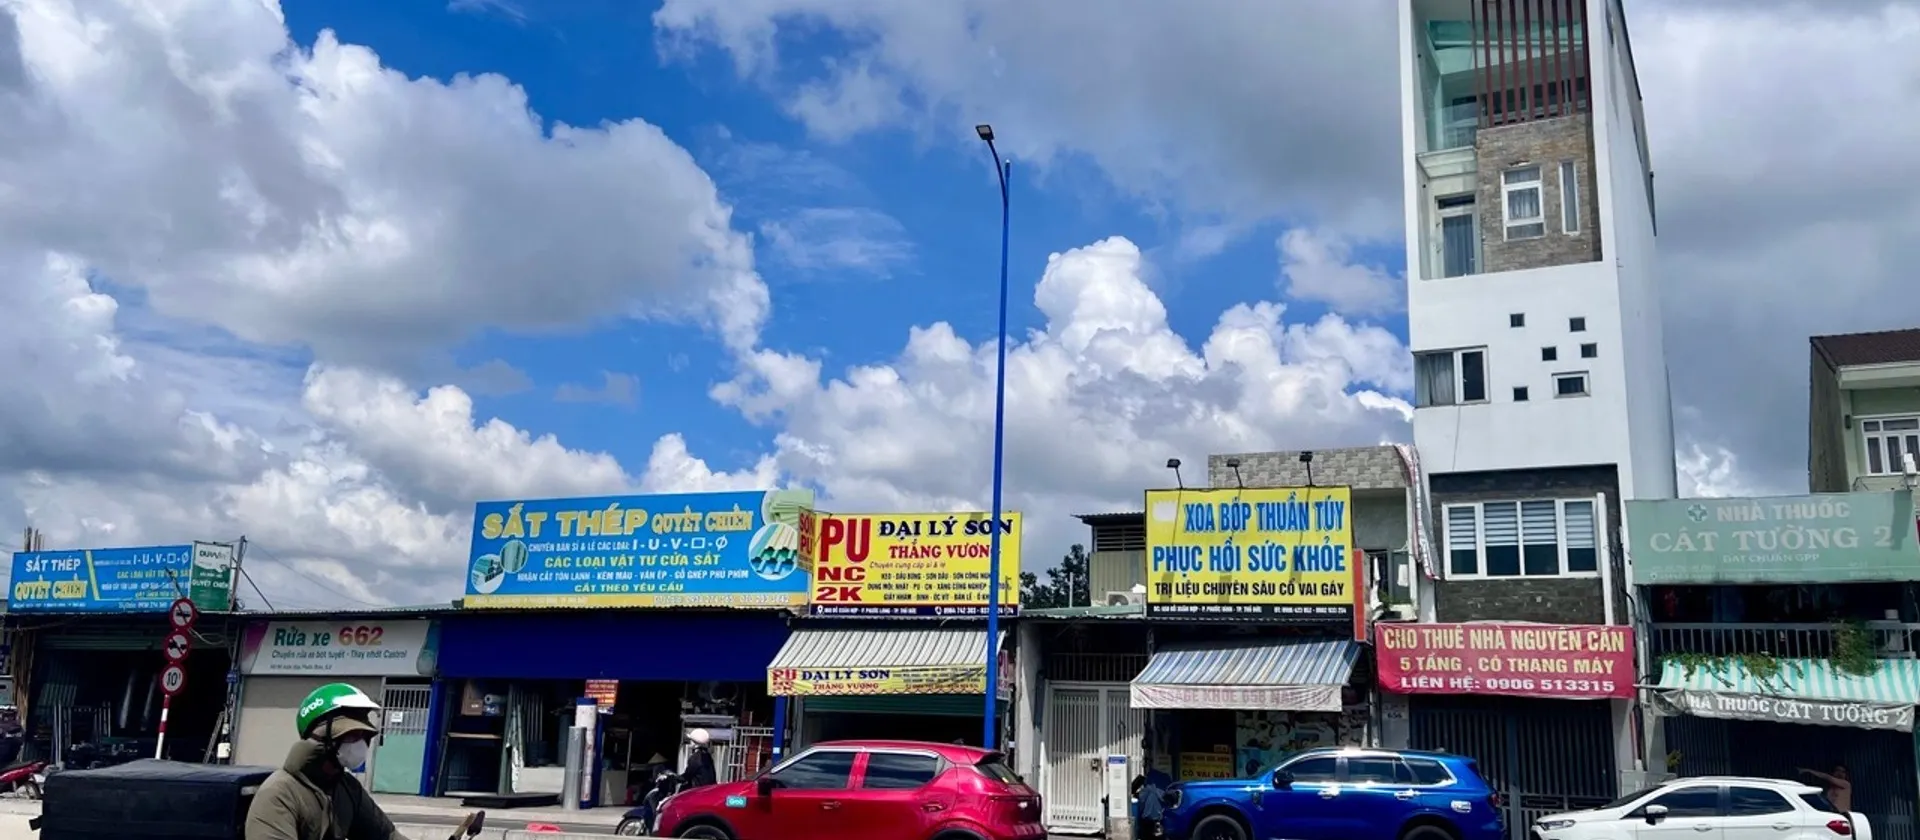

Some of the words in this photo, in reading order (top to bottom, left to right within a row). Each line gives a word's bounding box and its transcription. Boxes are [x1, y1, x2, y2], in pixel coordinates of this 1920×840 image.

[1184, 503, 1215, 533] XOA
[1256, 491, 1310, 533] THUẦN
[1313, 495, 1345, 532] TÚY
[1717, 502, 1766, 522] NHÀ
[1773, 497, 1849, 520] THUỐC
[482, 503, 548, 539] SẮT
[555, 503, 648, 536] THÉP
[879, 520, 921, 540] ĐẠI
[929, 515, 958, 536] LÝ
[648, 539, 660, 550] U
[671, 538, 682, 549] V
[820, 518, 871, 563] PU
[1732, 523, 1860, 551] TƯỜNG
[1874, 526, 1893, 547] 2
[889, 539, 941, 559] THẮNG
[1153, 544, 1203, 578] PHỤC
[1209, 536, 1241, 572] HỒI
[1248, 539, 1287, 572] SỨC
[1292, 536, 1346, 572] KHỎE
[1799, 553, 1820, 563] GPP
[26, 555, 48, 572] SẮT
[51, 555, 81, 571] THÉP
[545, 555, 571, 568] CÁC
[576, 556, 605, 571] LOẠI
[610, 555, 635, 570] VẬT
[640, 555, 658, 566] TƯ
[817, 567, 866, 581] NC
[574, 583, 596, 593] CẮT
[601, 583, 629, 593] THEO
[633, 582, 655, 592] YÊU
[816, 587, 862, 601] 2K
[1155, 582, 1173, 598] TRỊ
[1175, 579, 1200, 598] LIỆU
[1203, 580, 1249, 596] CHUYÊN
[1252, 580, 1275, 596] SÂU
[1298, 582, 1317, 596] VAI
[1321, 579, 1344, 596] GÁY
[273, 625, 306, 646] Rửa
[312, 632, 331, 646] xe
[338, 626, 384, 646] 662
[1384, 628, 1417, 650] CHO
[1422, 625, 1465, 650] THUÊ
[1470, 625, 1505, 650] NHÀ
[1511, 626, 1582, 651] NGUYÊN
[1400, 658, 1411, 671] 5
[1477, 654, 1501, 672] CÓ
[1507, 658, 1568, 674] THANG
[1574, 655, 1615, 674] MÁY
[773, 669, 797, 680] PU
[802, 670, 829, 683] ĐẠI
[859, 667, 890, 680] SƠN
[1400, 675, 1444, 689] LIÊN
[1450, 675, 1480, 692] HỆ:
[1487, 678, 1534, 690] 0906
[1540, 678, 1615, 692] 513315
[301, 697, 324, 718] Grab
[1716, 694, 1770, 712] THUỐC
[1896, 710, 1908, 726] 2
